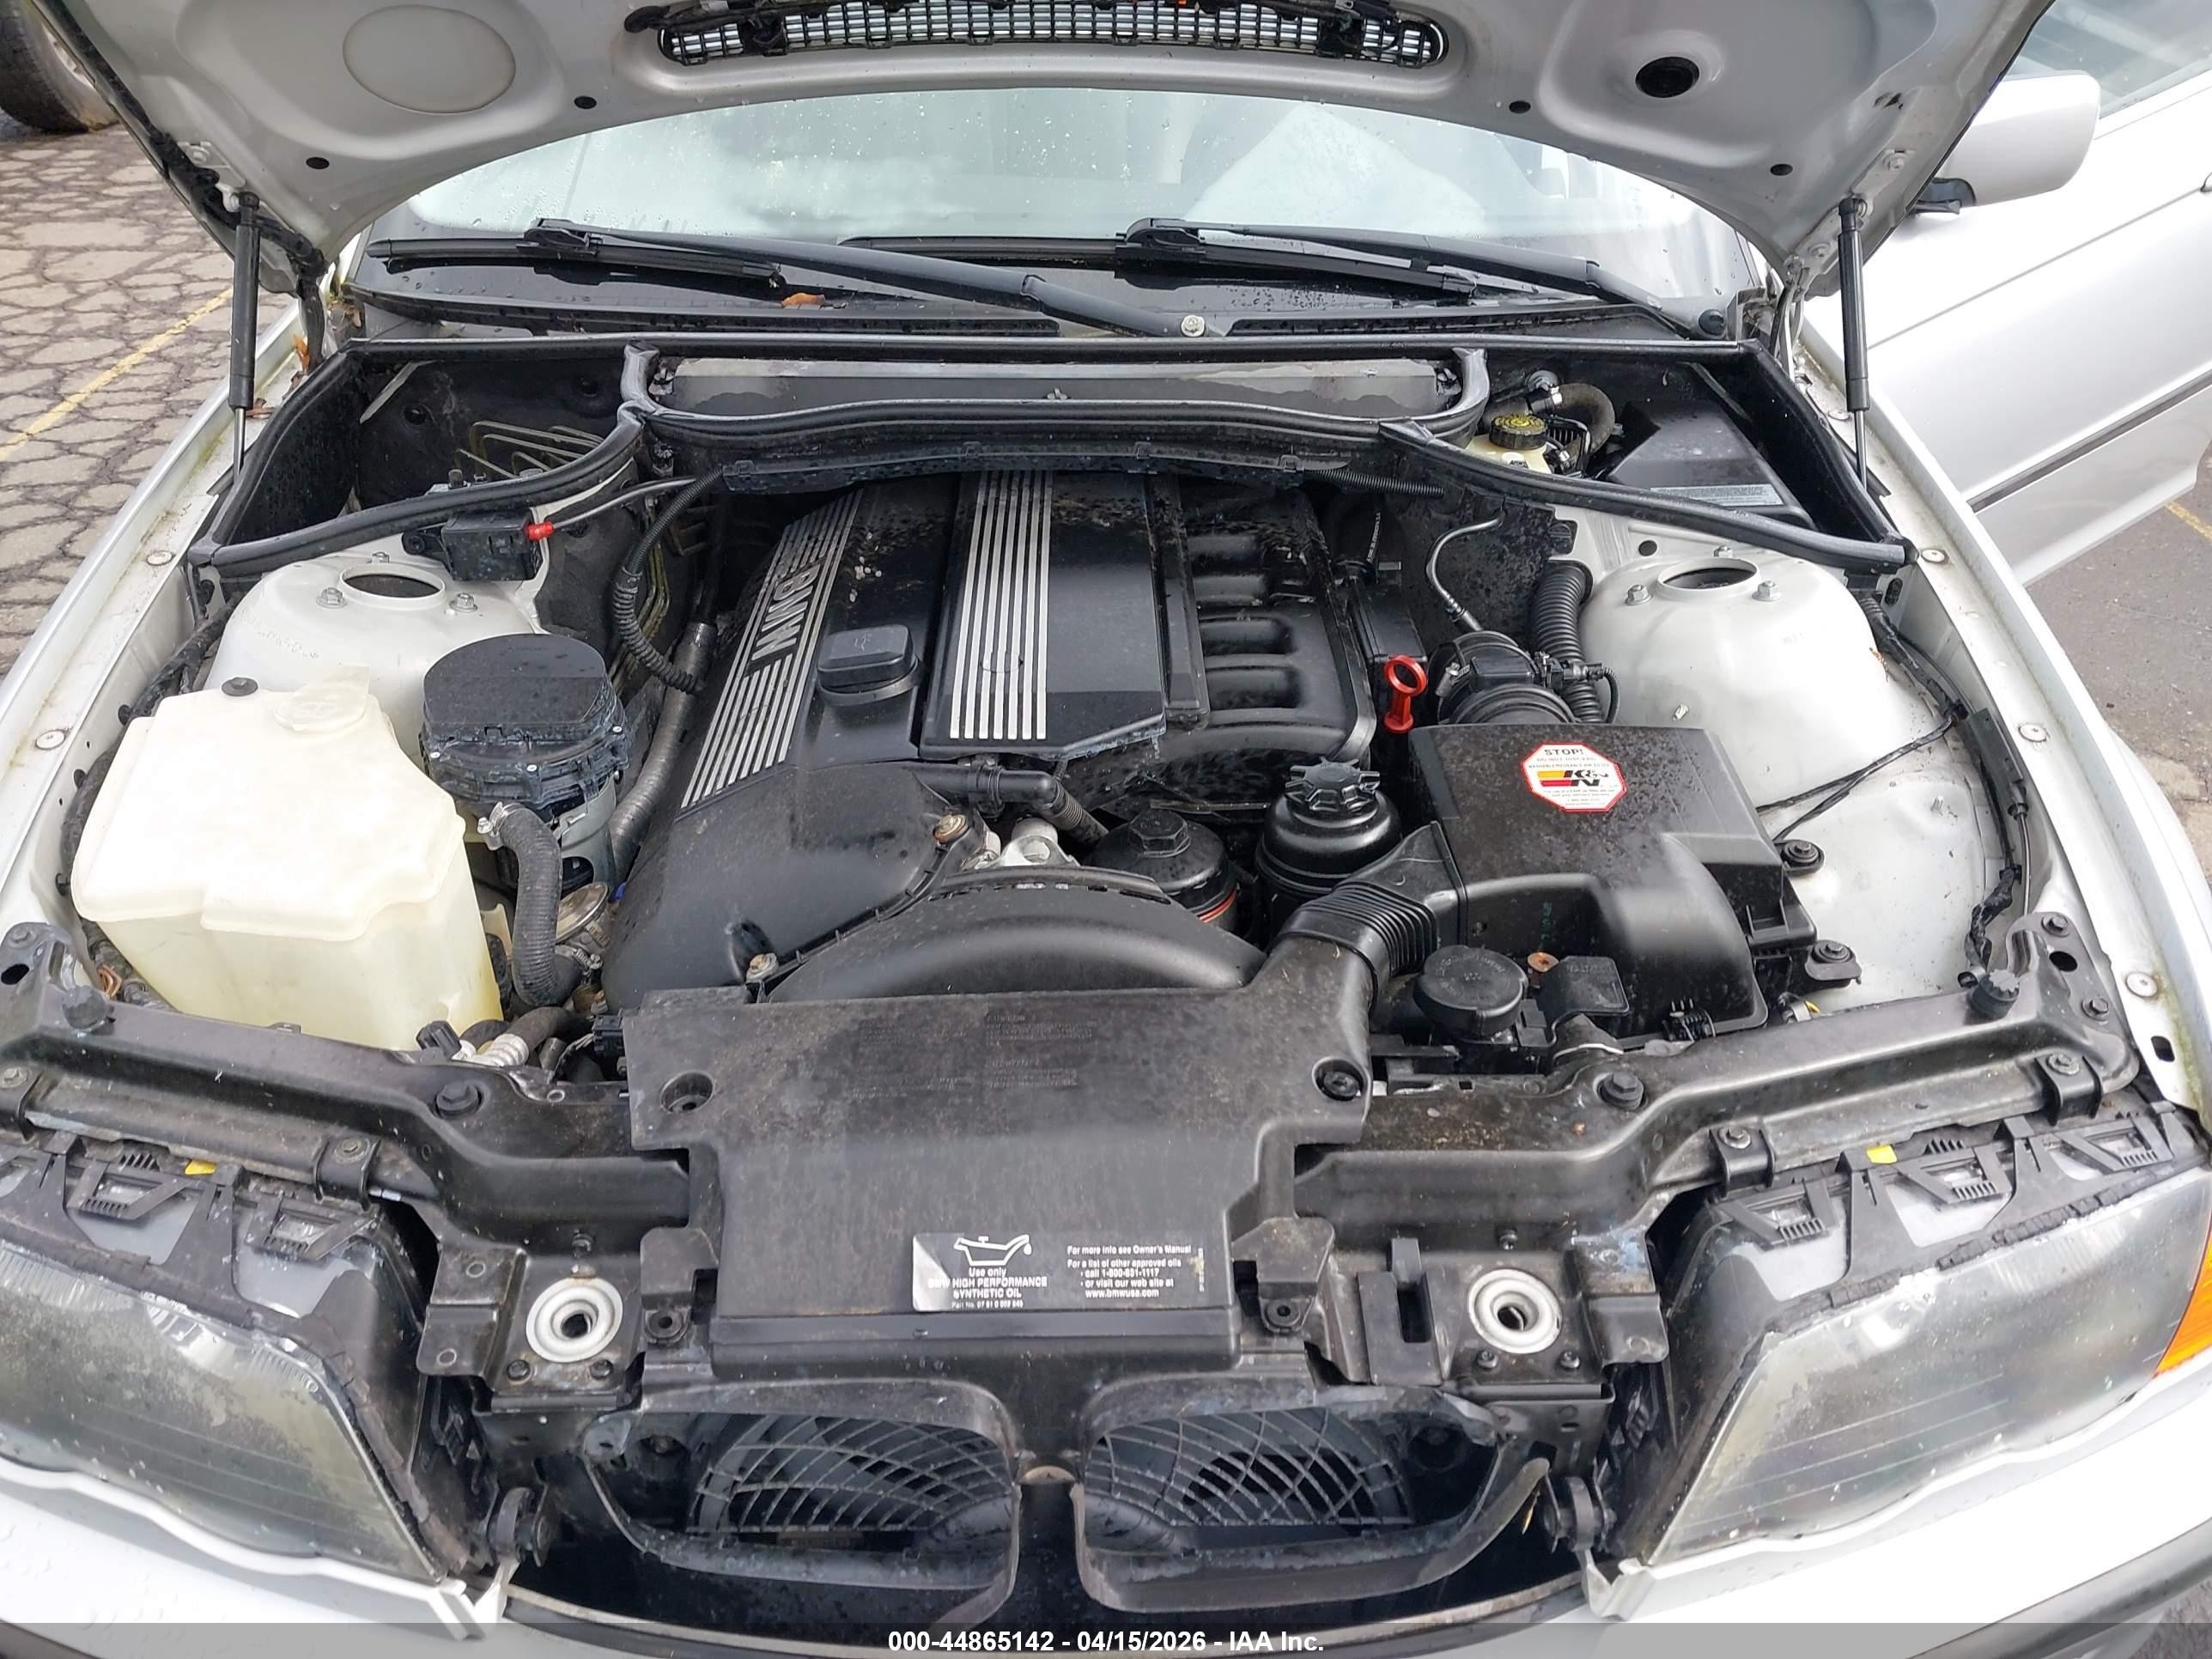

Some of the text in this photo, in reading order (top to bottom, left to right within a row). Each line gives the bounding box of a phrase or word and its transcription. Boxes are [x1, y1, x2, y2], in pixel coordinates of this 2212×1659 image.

[751, 564, 820, 660] BMW
[1067, 1244, 1192, 1255] For more info see Owner's Manual
[1067, 1259, 1080, 1268] For
[1088, 1259, 1100, 1268] list
[1101, 1258, 1109, 1267] of
[1110, 1258, 1130, 1267] other
[1132, 1258, 1166, 1269] approved
[1168, 1258, 1182, 1267] oils
[969, 1267, 1006, 1278] Use only
[1085, 1268, 1100, 1278] call
[952, 1277, 975, 1288] HIGH
[977, 1276, 1048, 1288] PERFORMANCE
[1085, 1278, 1174, 1288] or visit our web site at
[953, 1288, 1022, 1299] SYNTHETIC OIL
[1085, 1289, 1160, 1298] www.bmwusa.com
